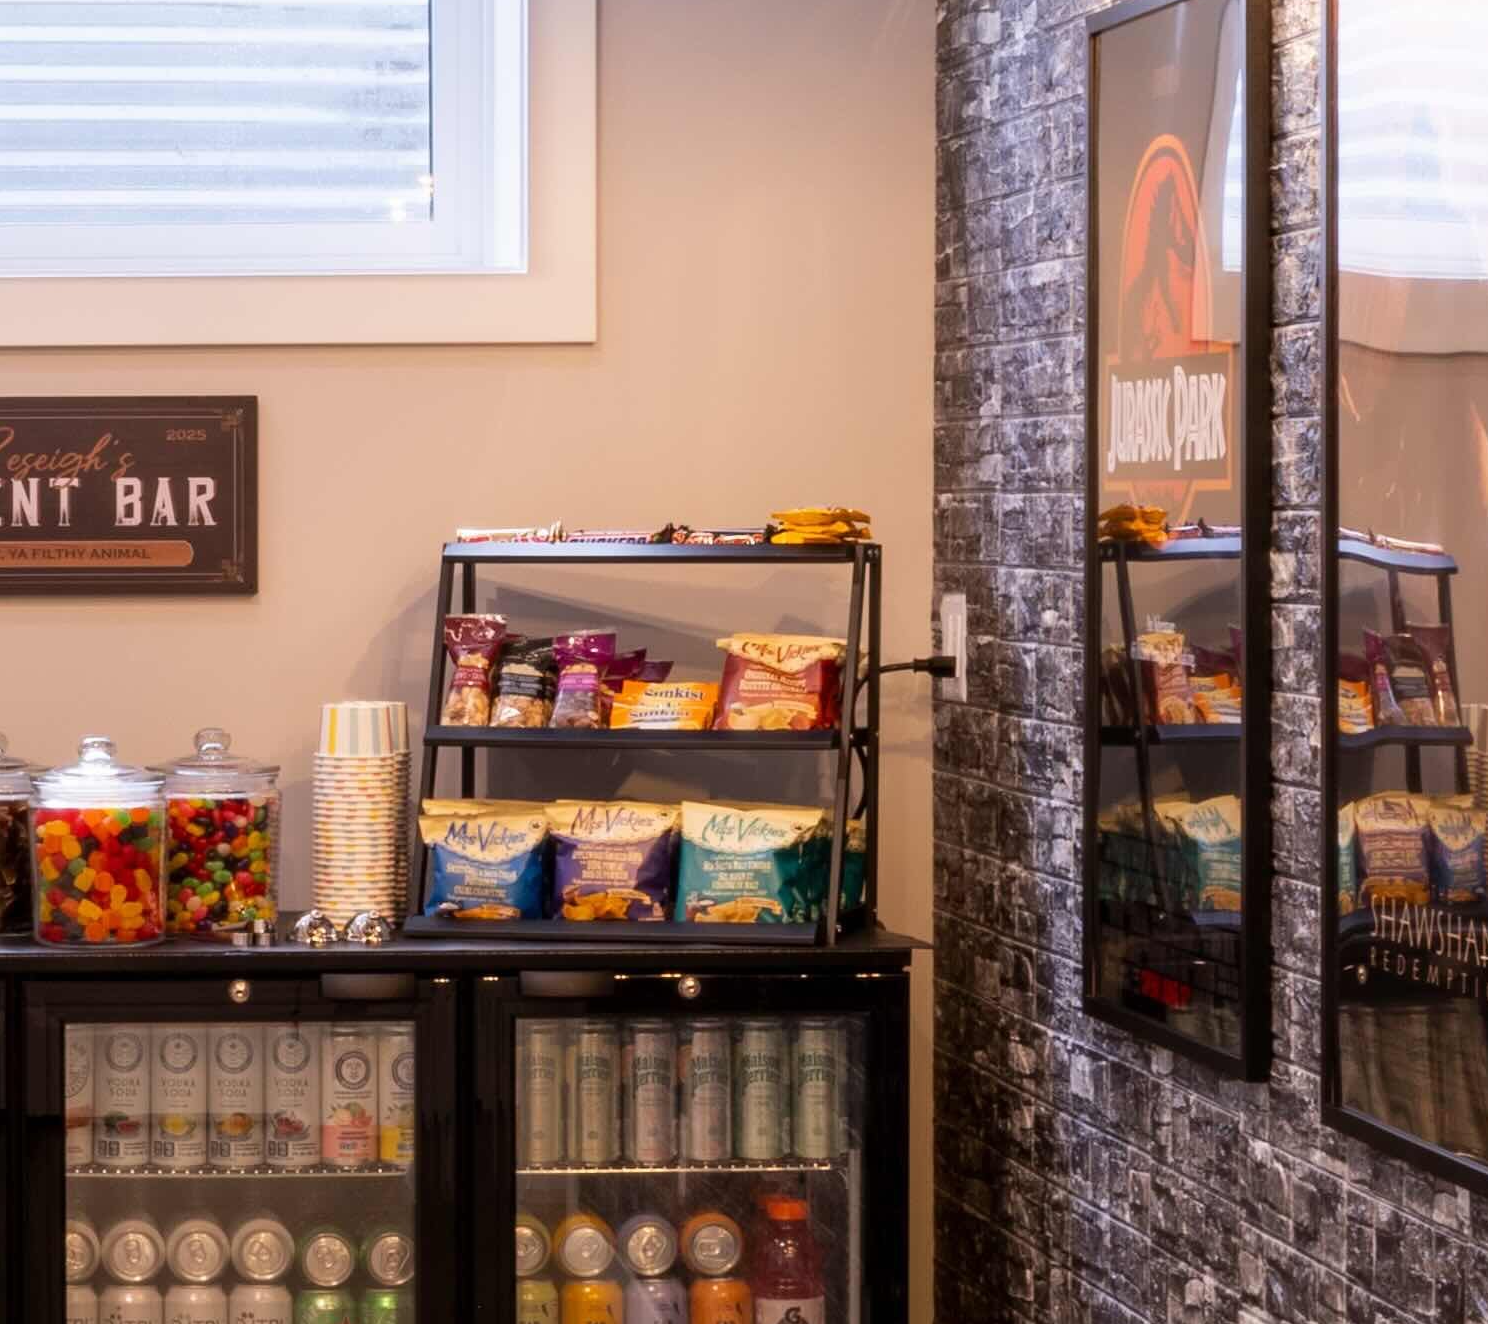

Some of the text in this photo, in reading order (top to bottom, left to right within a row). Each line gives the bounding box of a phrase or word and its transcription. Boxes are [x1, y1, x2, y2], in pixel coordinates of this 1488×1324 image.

[1108, 365, 1226, 473] JURASSIC PARK
[166, 429, 207, 441] 2025
[114, 477, 217, 526] BAR
[10, 548, 29, 560] YA
[32, 548, 86, 560] FILTHY
[91, 548, 150, 560] ANIMAL
[644, 687, 706, 701] Sunkist
